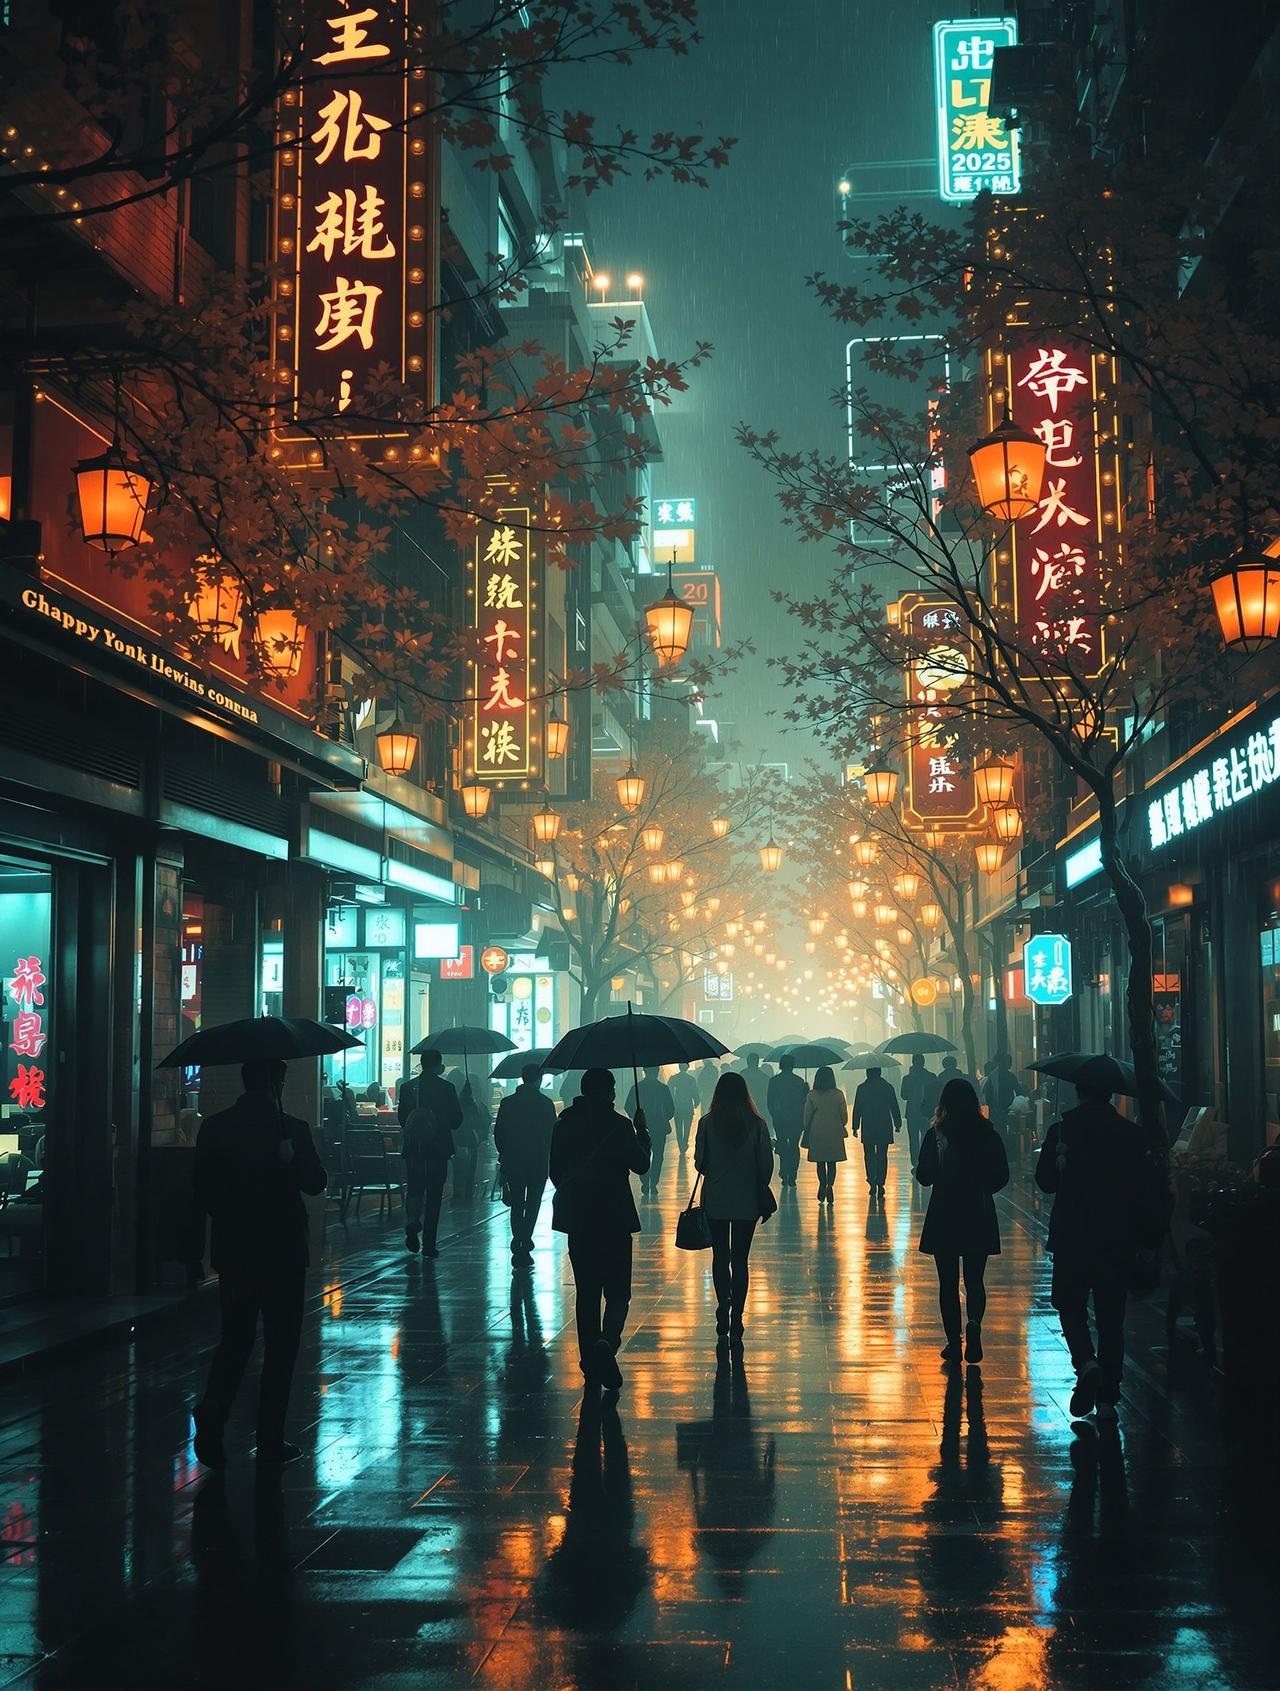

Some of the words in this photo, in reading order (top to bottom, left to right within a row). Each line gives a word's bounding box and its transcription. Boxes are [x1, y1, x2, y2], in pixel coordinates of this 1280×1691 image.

[952, 153, 1011, 171] 2025
[683, 583, 708, 600] 20
[104, 629, 147, 665] Yonk
